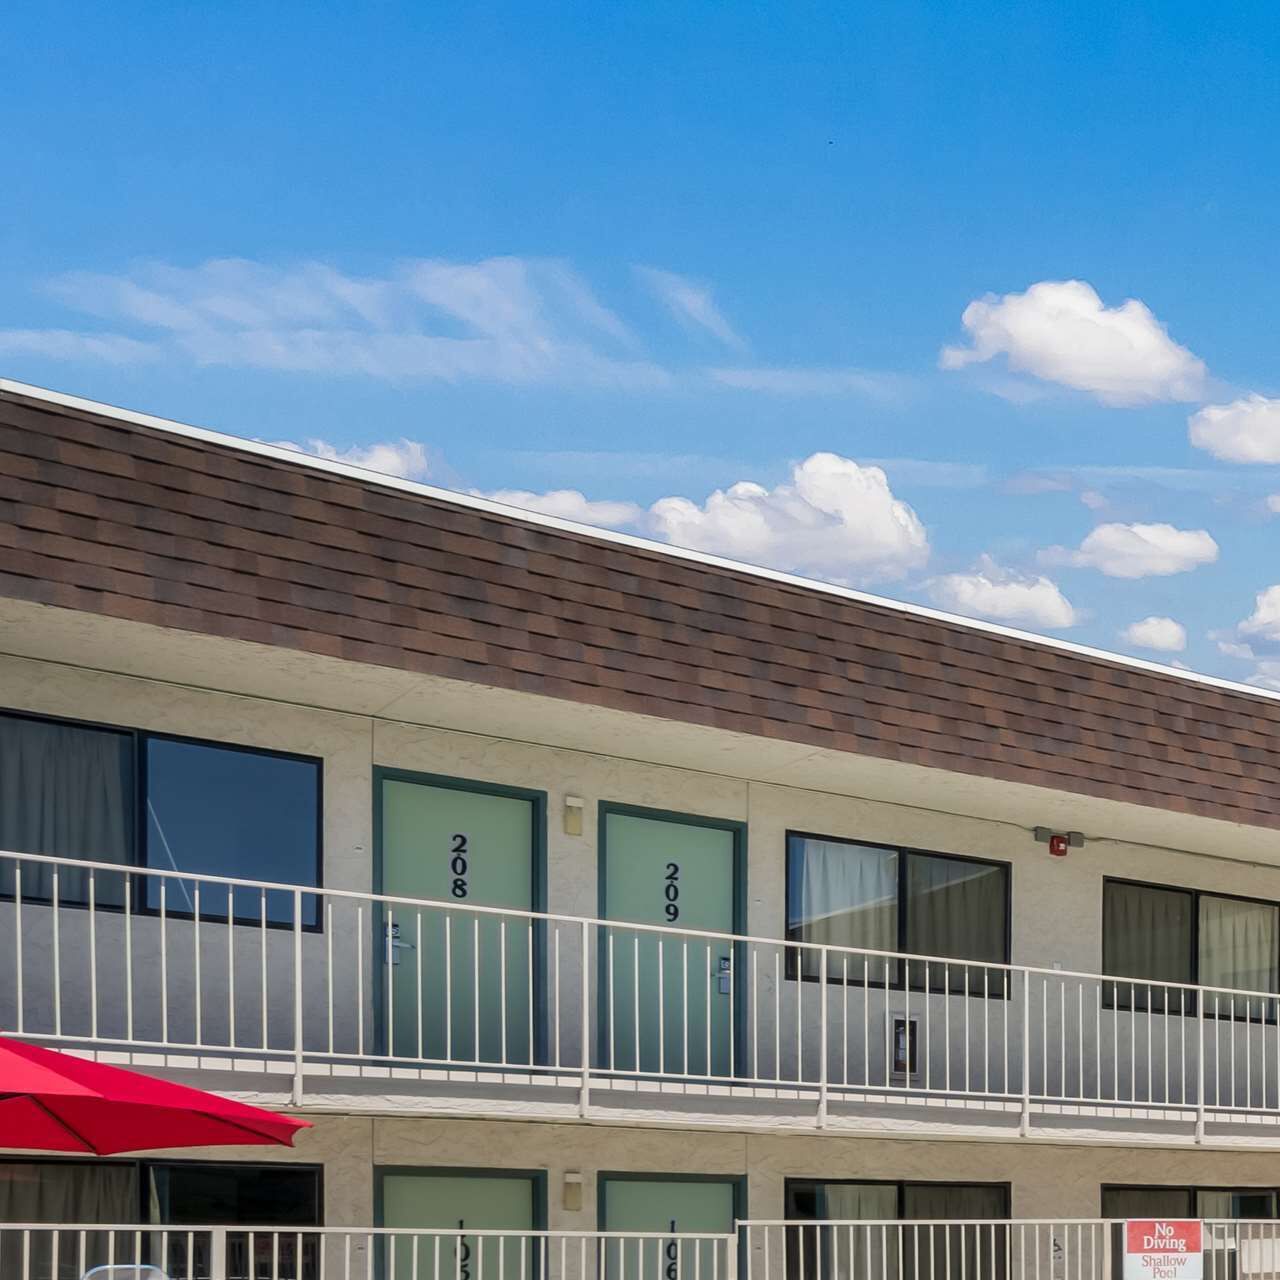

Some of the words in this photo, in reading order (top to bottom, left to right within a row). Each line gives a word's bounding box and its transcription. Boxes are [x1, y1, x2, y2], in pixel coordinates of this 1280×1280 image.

[451, 834, 468, 898] 208
[664, 863, 680, 922] 209
[1155, 1223, 1174, 1237] No
[1143, 1235, 1186, 1252] Diving
[1142, 1255, 1187, 1267] Shallow
[1153, 1267, 1177, 1279] Pool
